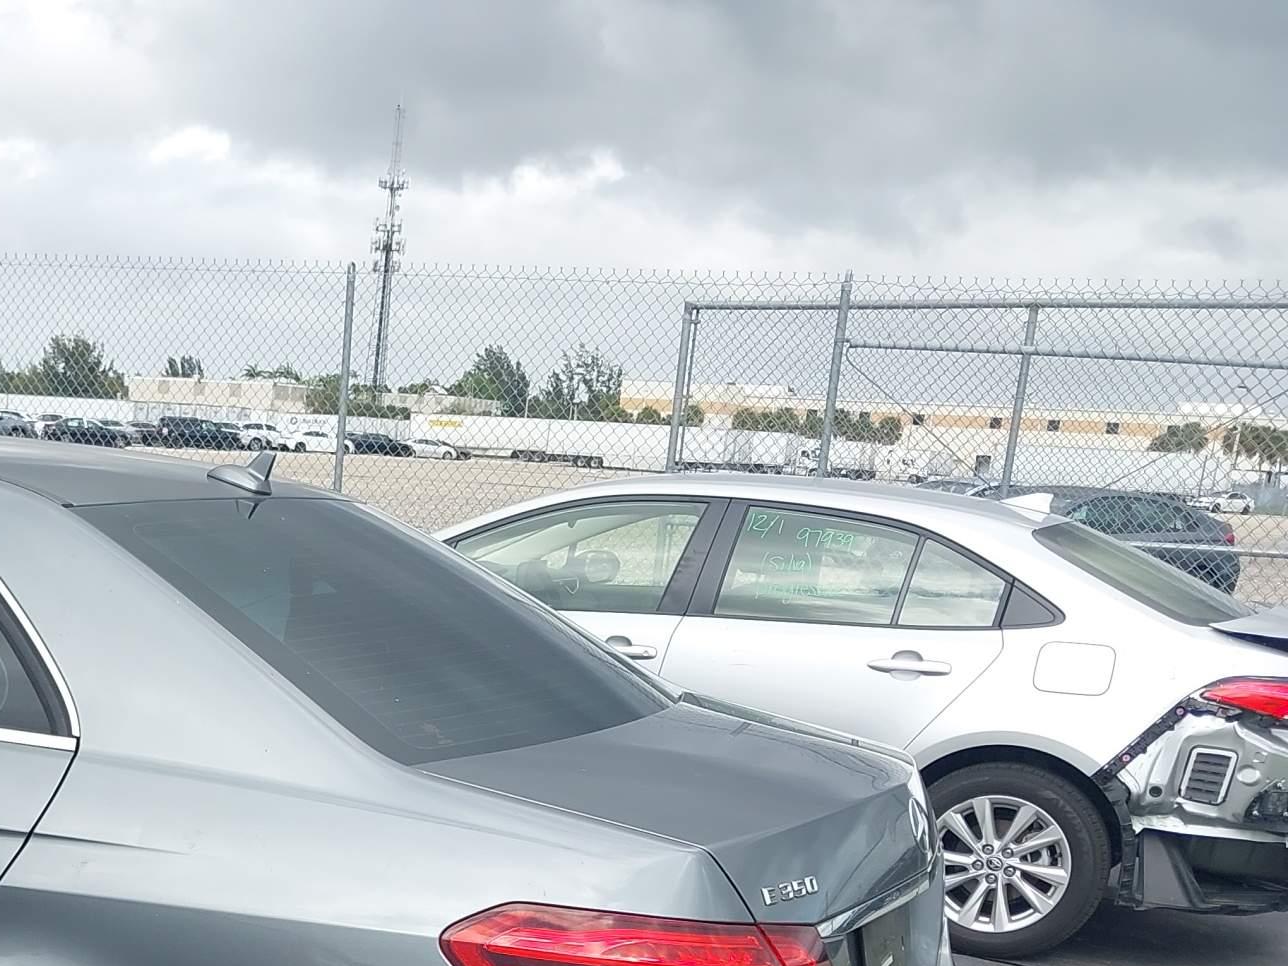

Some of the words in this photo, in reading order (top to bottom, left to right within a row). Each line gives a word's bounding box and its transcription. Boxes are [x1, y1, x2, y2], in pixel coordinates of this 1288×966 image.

[747, 513, 784, 538] 12/1
[796, 527, 854, 551] 97939
[761, 887, 777, 906] E
[778, 875, 818, 901] 350
